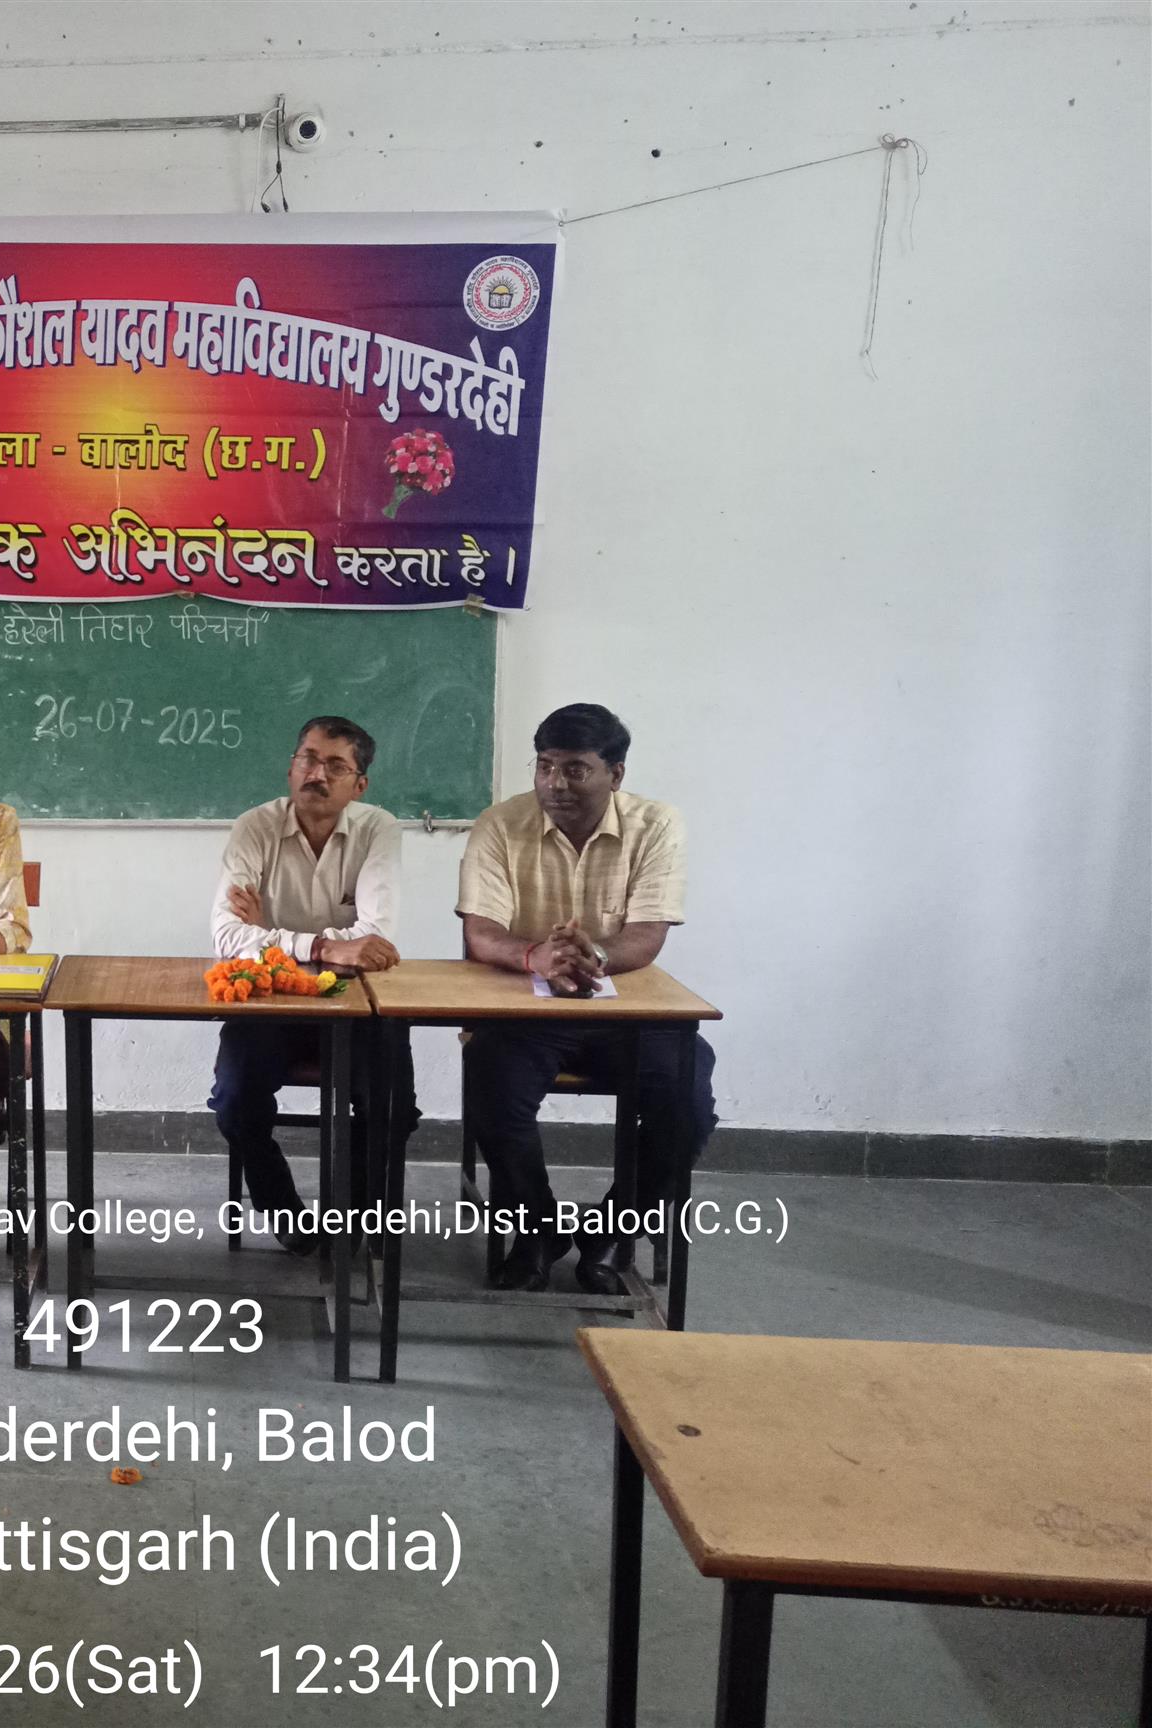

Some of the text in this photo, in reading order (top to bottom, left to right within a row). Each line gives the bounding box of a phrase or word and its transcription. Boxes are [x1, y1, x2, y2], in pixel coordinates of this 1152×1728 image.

[80, 299, 172, 373] यादव
[173, 277, 371, 394] महाविद्यालय
[373, 336, 526, 436] गुण्डरदेही
[78, 424, 189, 471] बालोद
[203, 427, 327, 481] (छ.ग.)
[62, 506, 329, 587] अभिनंदन
[333, 546, 450, 586] करता
[32, 694, 243, 749] 26-07-2025
